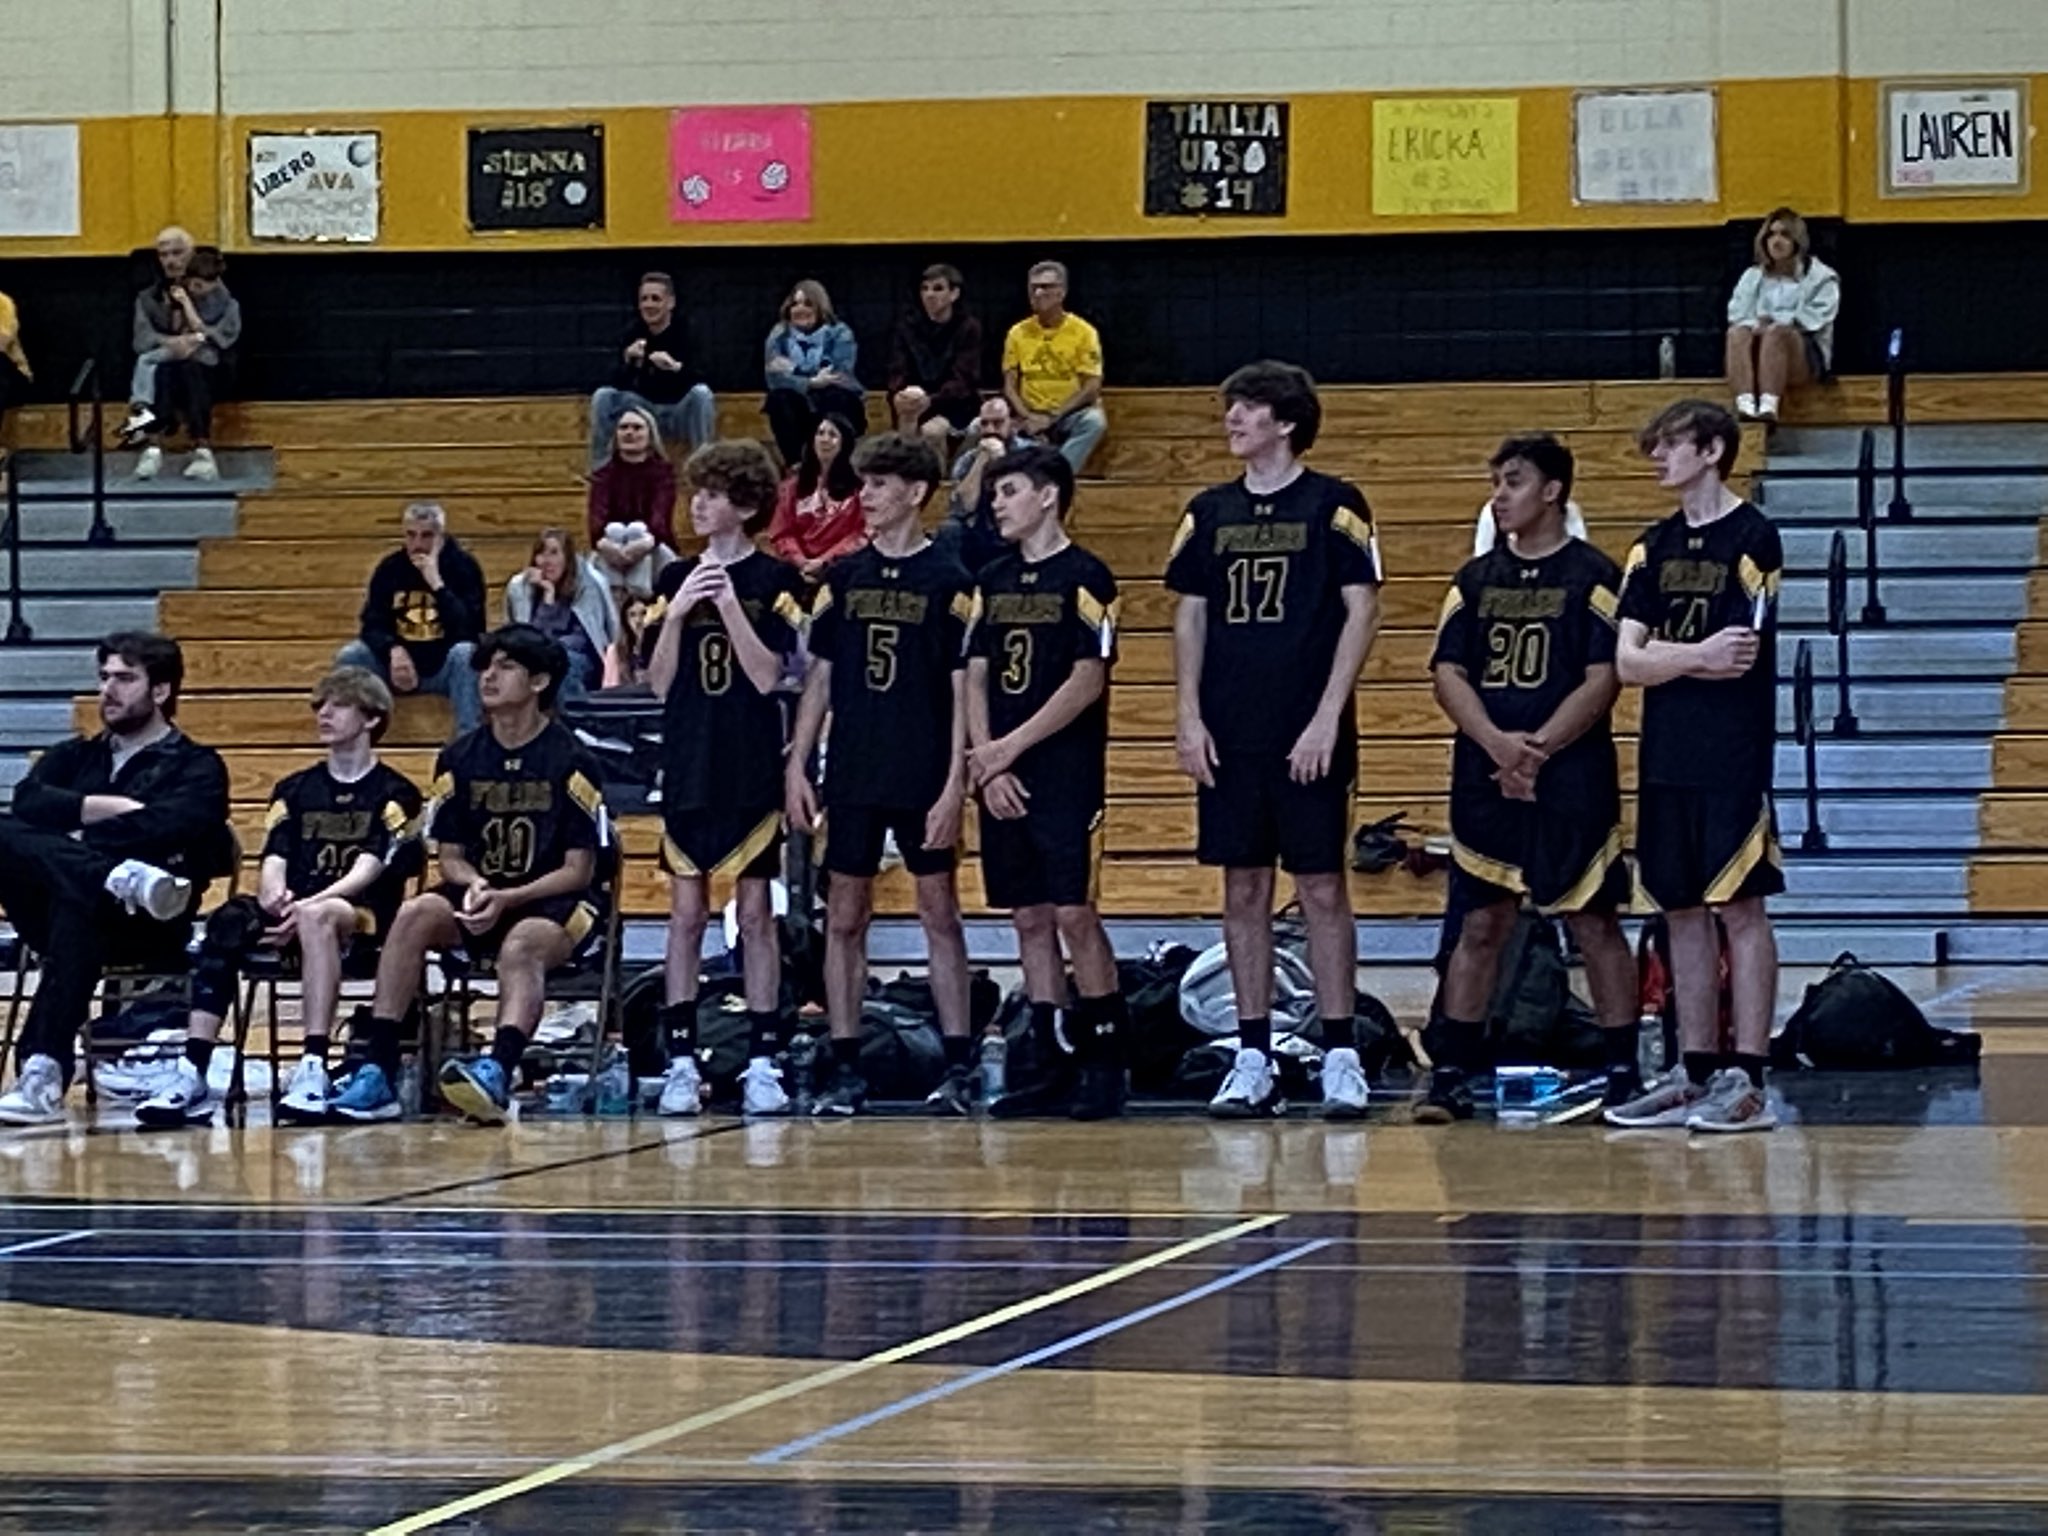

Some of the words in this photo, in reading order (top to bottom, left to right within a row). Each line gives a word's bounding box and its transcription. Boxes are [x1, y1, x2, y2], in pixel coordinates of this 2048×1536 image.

[1169, 102, 1281, 137] THALIA
[1387, 127, 1487, 162] ERICKA
[1901, 109, 2013, 162] LAUREN
[253, 150, 316, 198] LIBERO
[307, 172, 355, 190] AVA
[482, 149, 587, 176] SIENNA
[1226, 556, 1289, 624] 17
[700, 632, 732, 695] 8
[866, 624, 899, 692] 5
[1001, 628, 1032, 694] 3
[1480, 621, 1549, 689] 20
